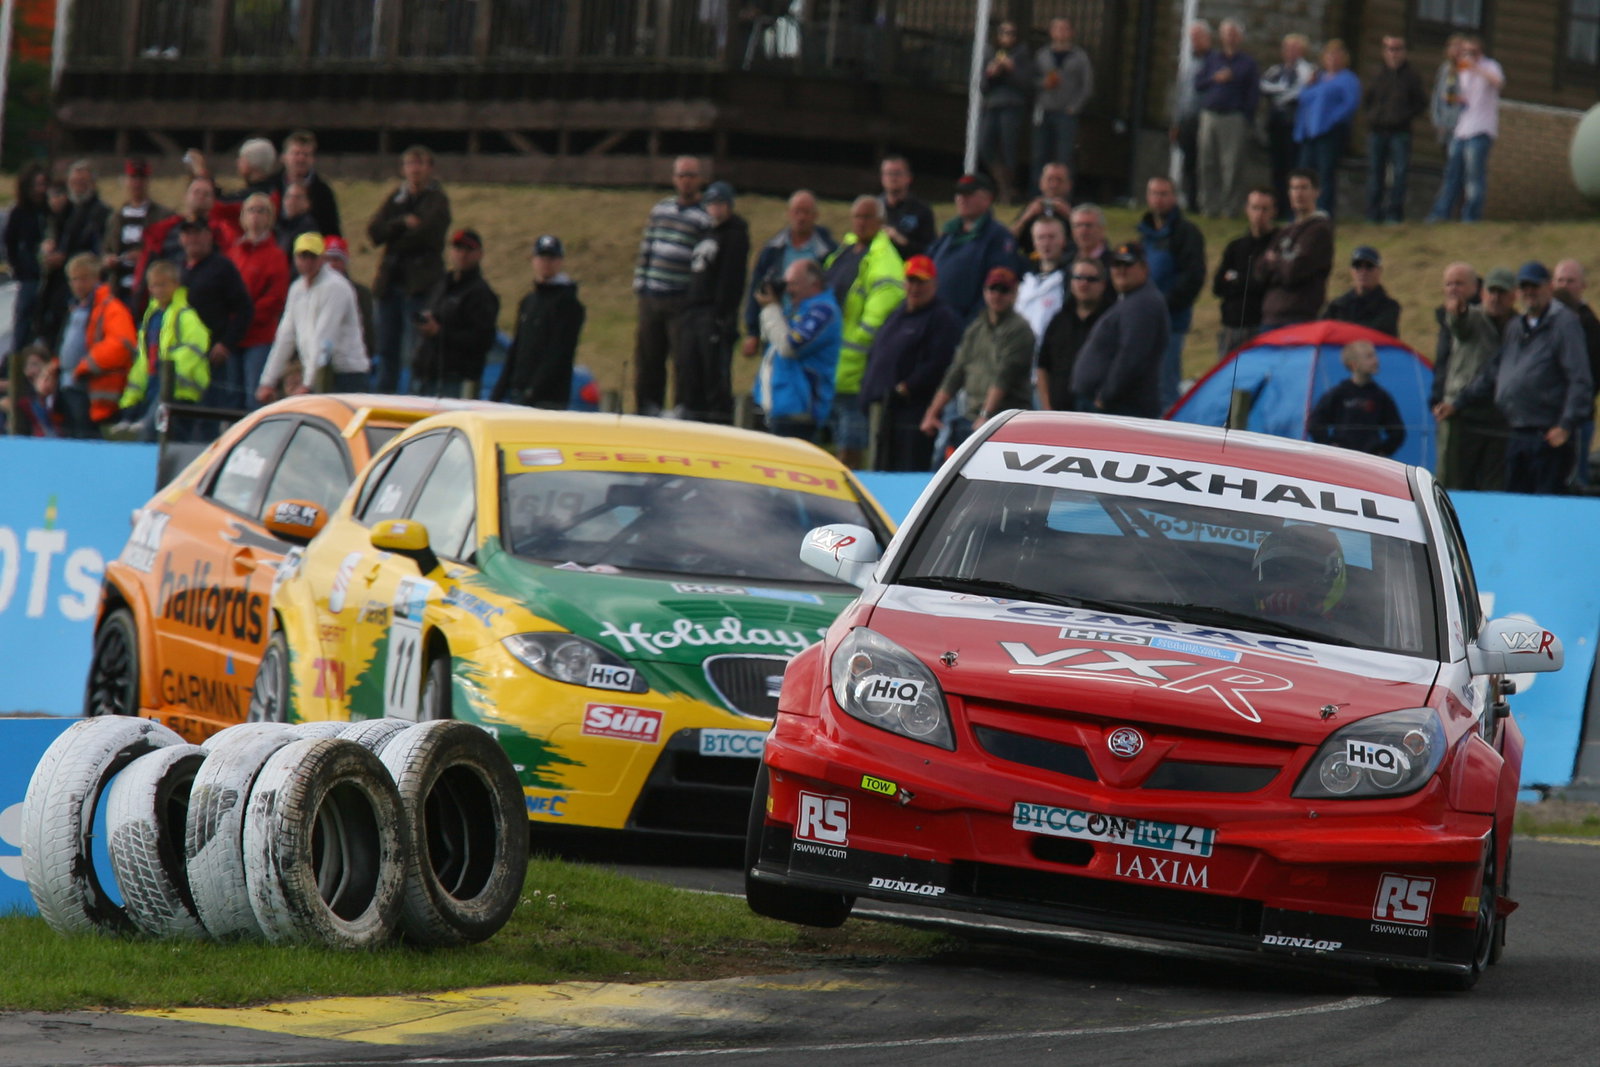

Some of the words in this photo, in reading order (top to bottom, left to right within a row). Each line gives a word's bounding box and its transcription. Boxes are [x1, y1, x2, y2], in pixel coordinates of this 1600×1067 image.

[750, 465, 840, 491] TDI
[1002, 450, 1400, 523] VAUXHALL
[811, 527, 857, 563] VXR
[156, 551, 263, 645] halfords
[600, 616, 813, 656] Holiday
[1005, 606, 1314, 652] GMAC
[1068, 628, 1147, 645] HiQ
[1499, 631, 1556, 660] VXR
[390, 636, 416, 710] 11
[590, 667, 630, 687] HiQ
[1000, 641, 1294, 724] VXR
[161, 668, 243, 721] GARMIN
[871, 679, 919, 703] HiQ
[585, 706, 659, 735] Sun
[703, 734, 765, 755] BTCC
[1349, 743, 1396, 770] HiQ
[866, 778, 892, 793] TOW
[799, 794, 848, 843] RS
[1015, 803, 1087, 833] BTCC
[1136, 821, 1174, 845] itv
[1180, 825, 1197, 850] 4
[792, 841, 848, 860] rswww.com
[868, 876, 946, 897] DUNLOP
[1375, 875, 1433, 922] RS
[1261, 933, 1343, 952] DUNLOP
[1369, 921, 1429, 938] rswww.com
